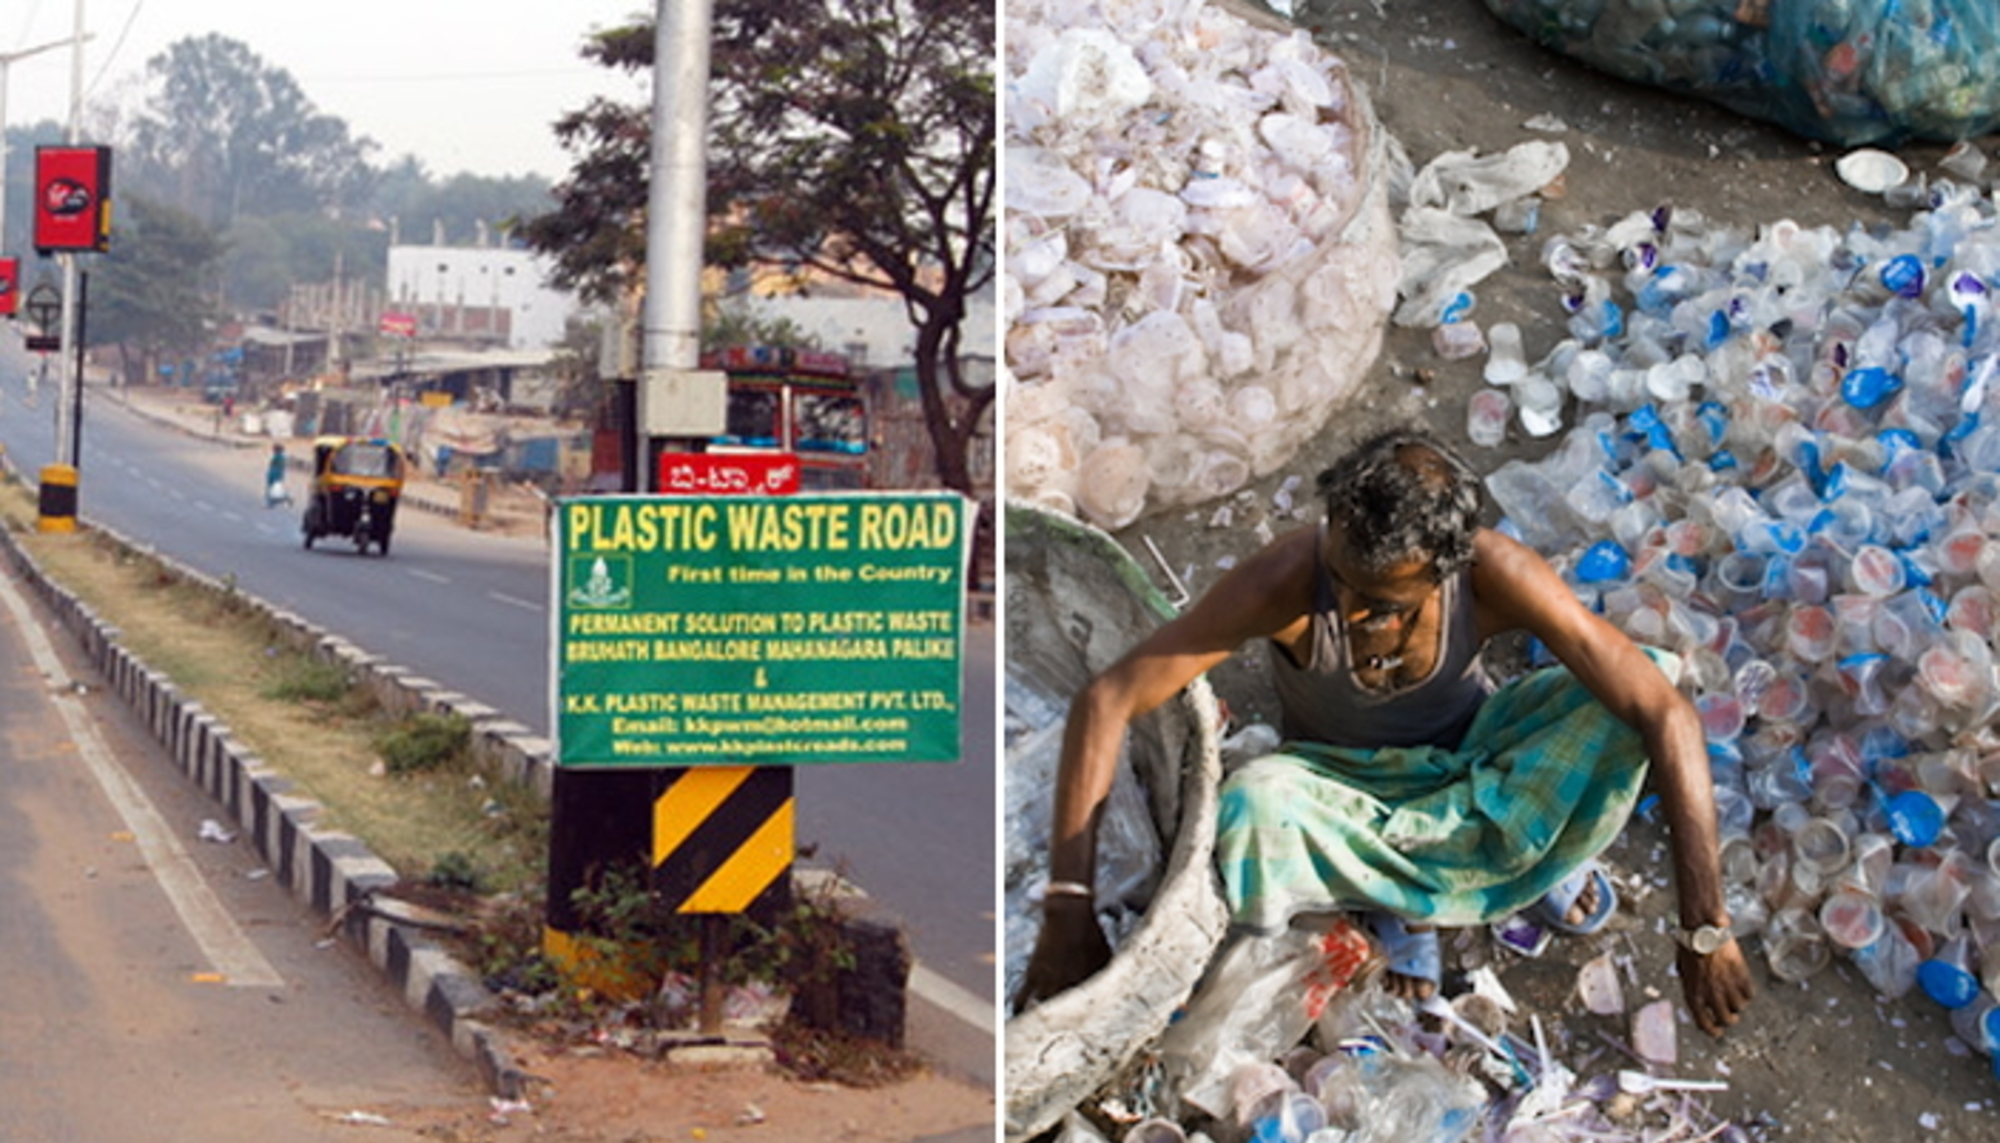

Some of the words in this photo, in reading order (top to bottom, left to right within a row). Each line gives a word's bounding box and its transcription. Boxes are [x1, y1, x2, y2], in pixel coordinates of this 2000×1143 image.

[570, 505, 717, 550] PLASTIC
[728, 505, 849, 550] WASTE
[860, 504, 956, 550] ROAD
[668, 565, 722, 582] First
[729, 566, 780, 582] time
[786, 566, 807, 581] in
[815, 565, 852, 581] the
[859, 564, 952, 583] Country
[570, 613, 680, 634] PERMANENT
[685, 613, 776, 632] SOLUTION
[782, 612, 805, 632] TO
[809, 612, 883, 632] PLASTIC
[888, 611, 951, 632] WASTE
[567, 640, 650, 661] BRUHATH
[654, 640, 761, 660] BANGALORE
[766, 640, 888, 660] MAHANAGARA
[892, 639, 955, 660] PALIKE
[754, 667, 768, 687] &
[568, 694, 600, 713] K.K.
[605, 694, 678, 713] PLASTIC
[682, 693, 742, 712] WASTE
[747, 692, 866, 711] MANAGEMENT
[612, 717, 679, 734] Email:
[684, 716, 909, 737] kkpwm@hotmail.com
